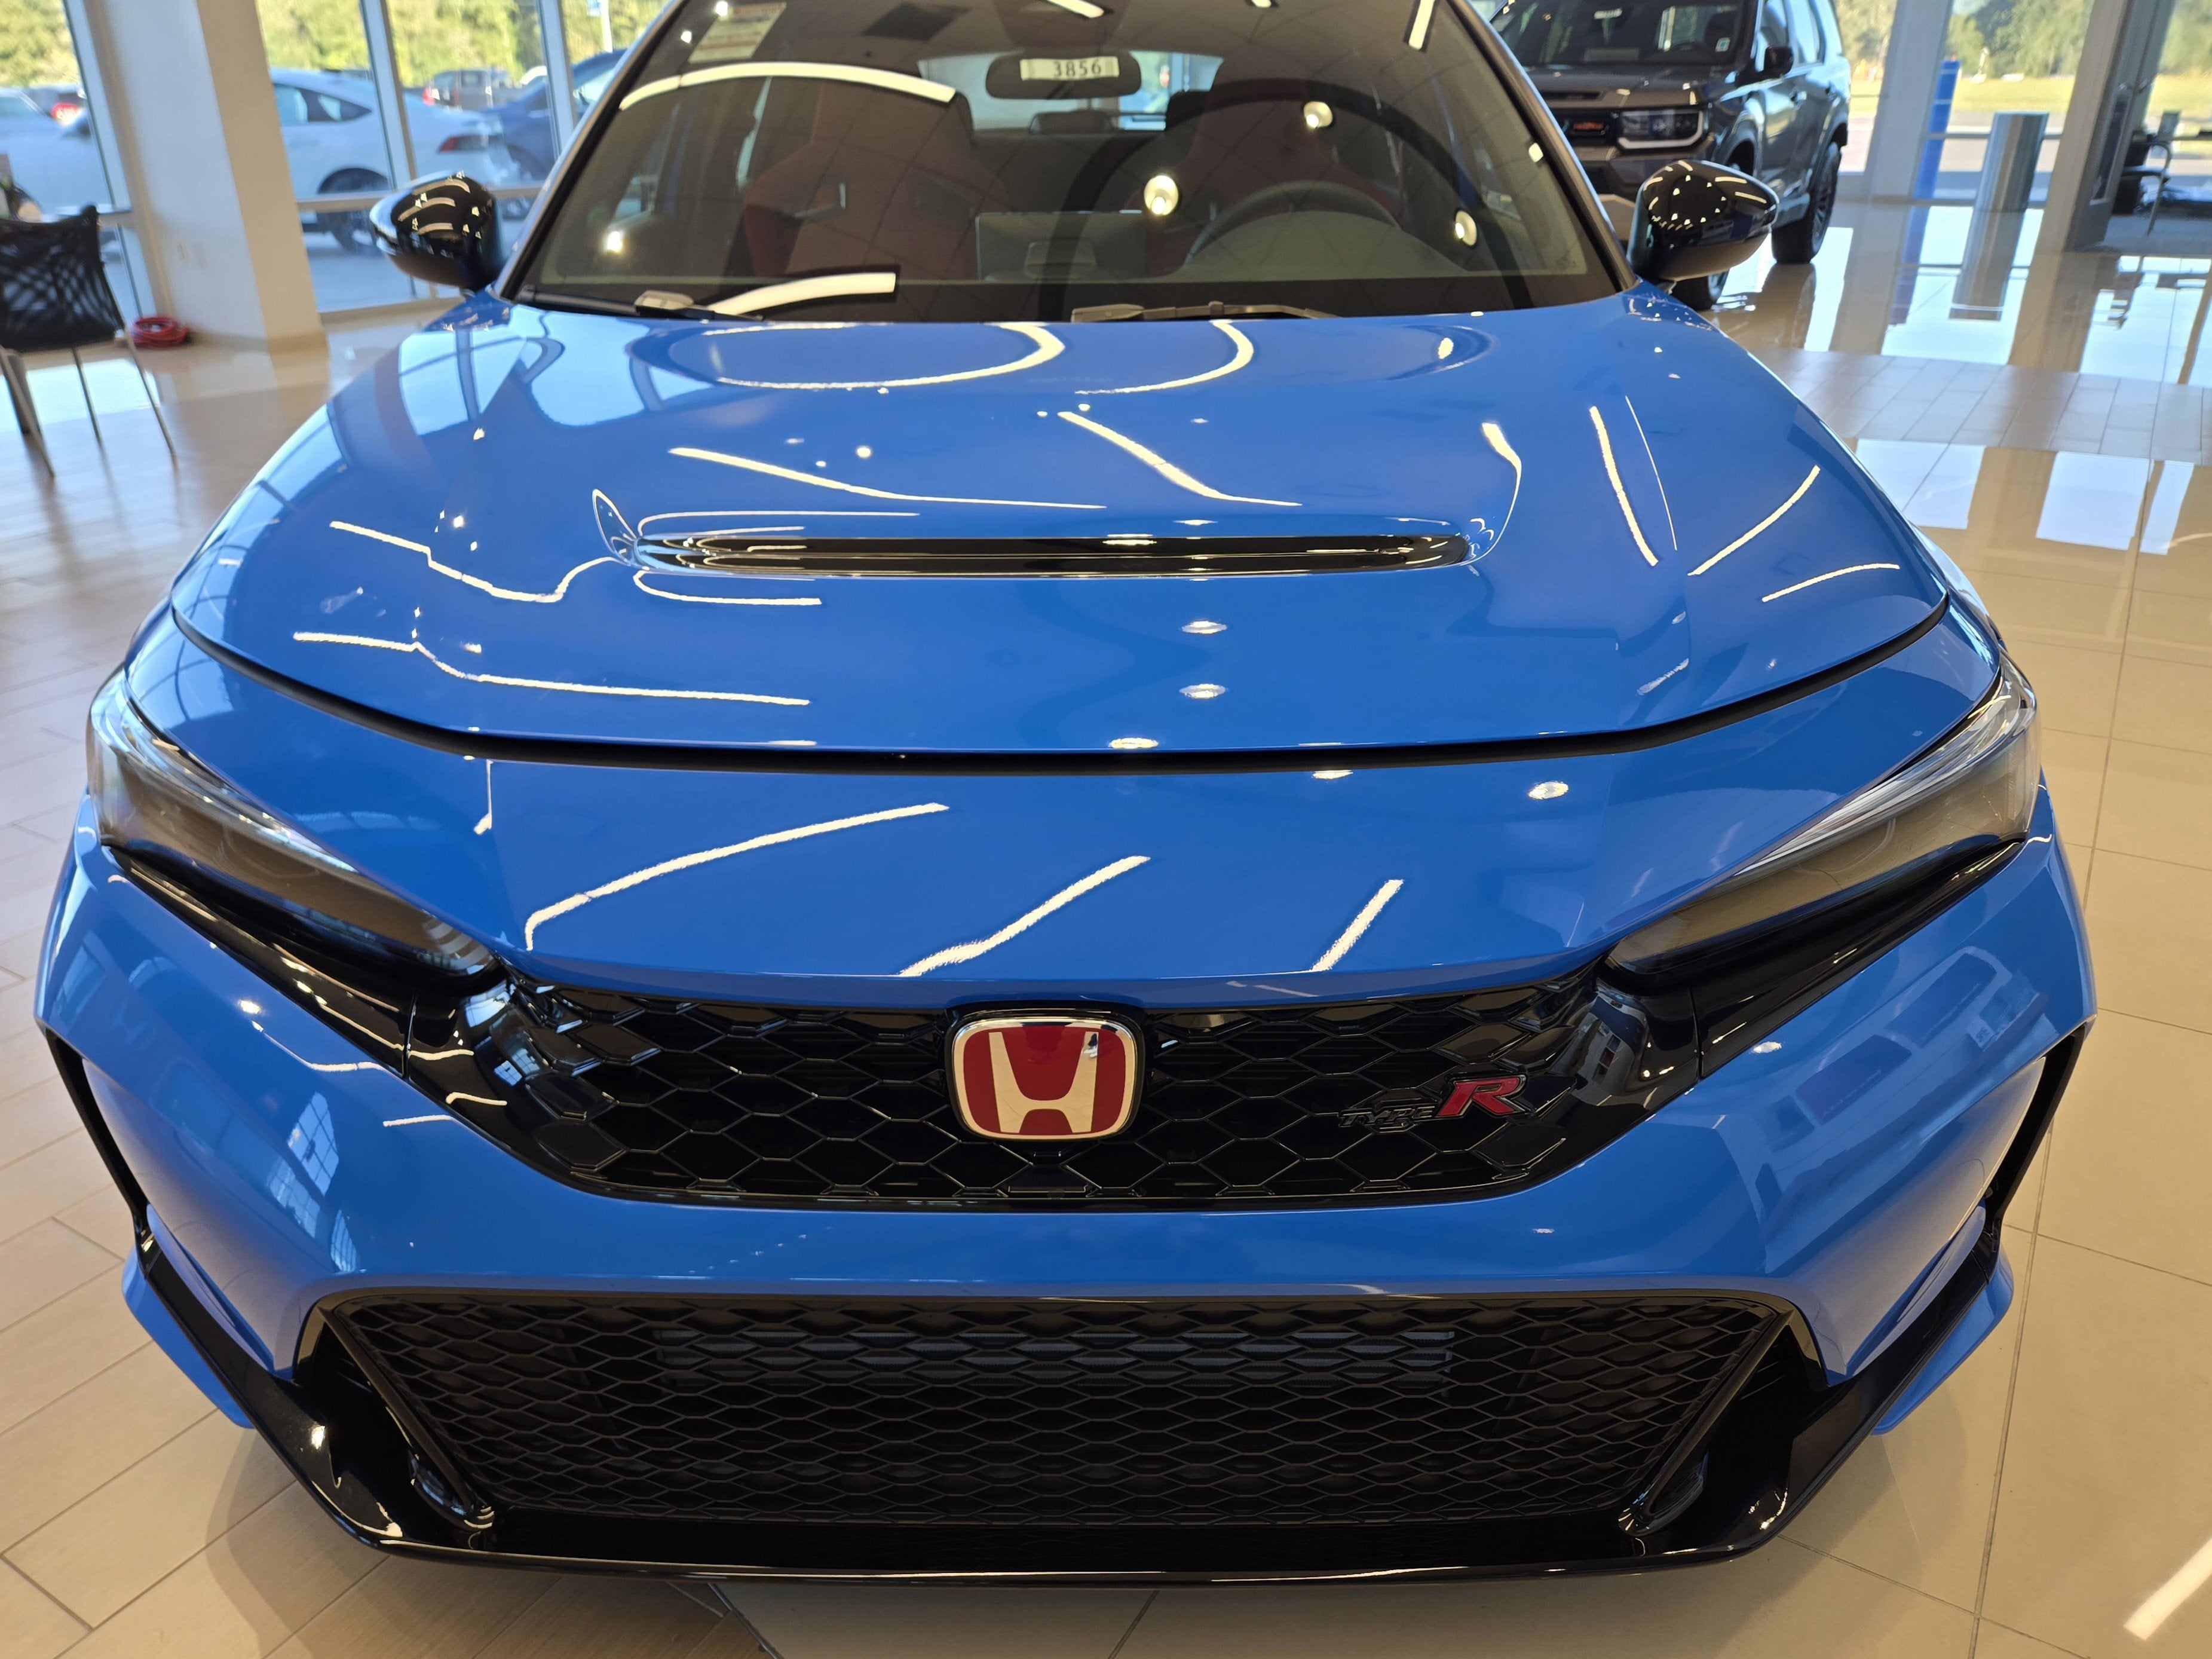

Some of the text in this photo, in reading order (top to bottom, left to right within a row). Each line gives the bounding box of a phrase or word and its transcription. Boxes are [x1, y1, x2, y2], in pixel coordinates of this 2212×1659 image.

[1053, 59, 1102, 77] 3856
[1338, 1076, 1526, 1127] TYPE R
